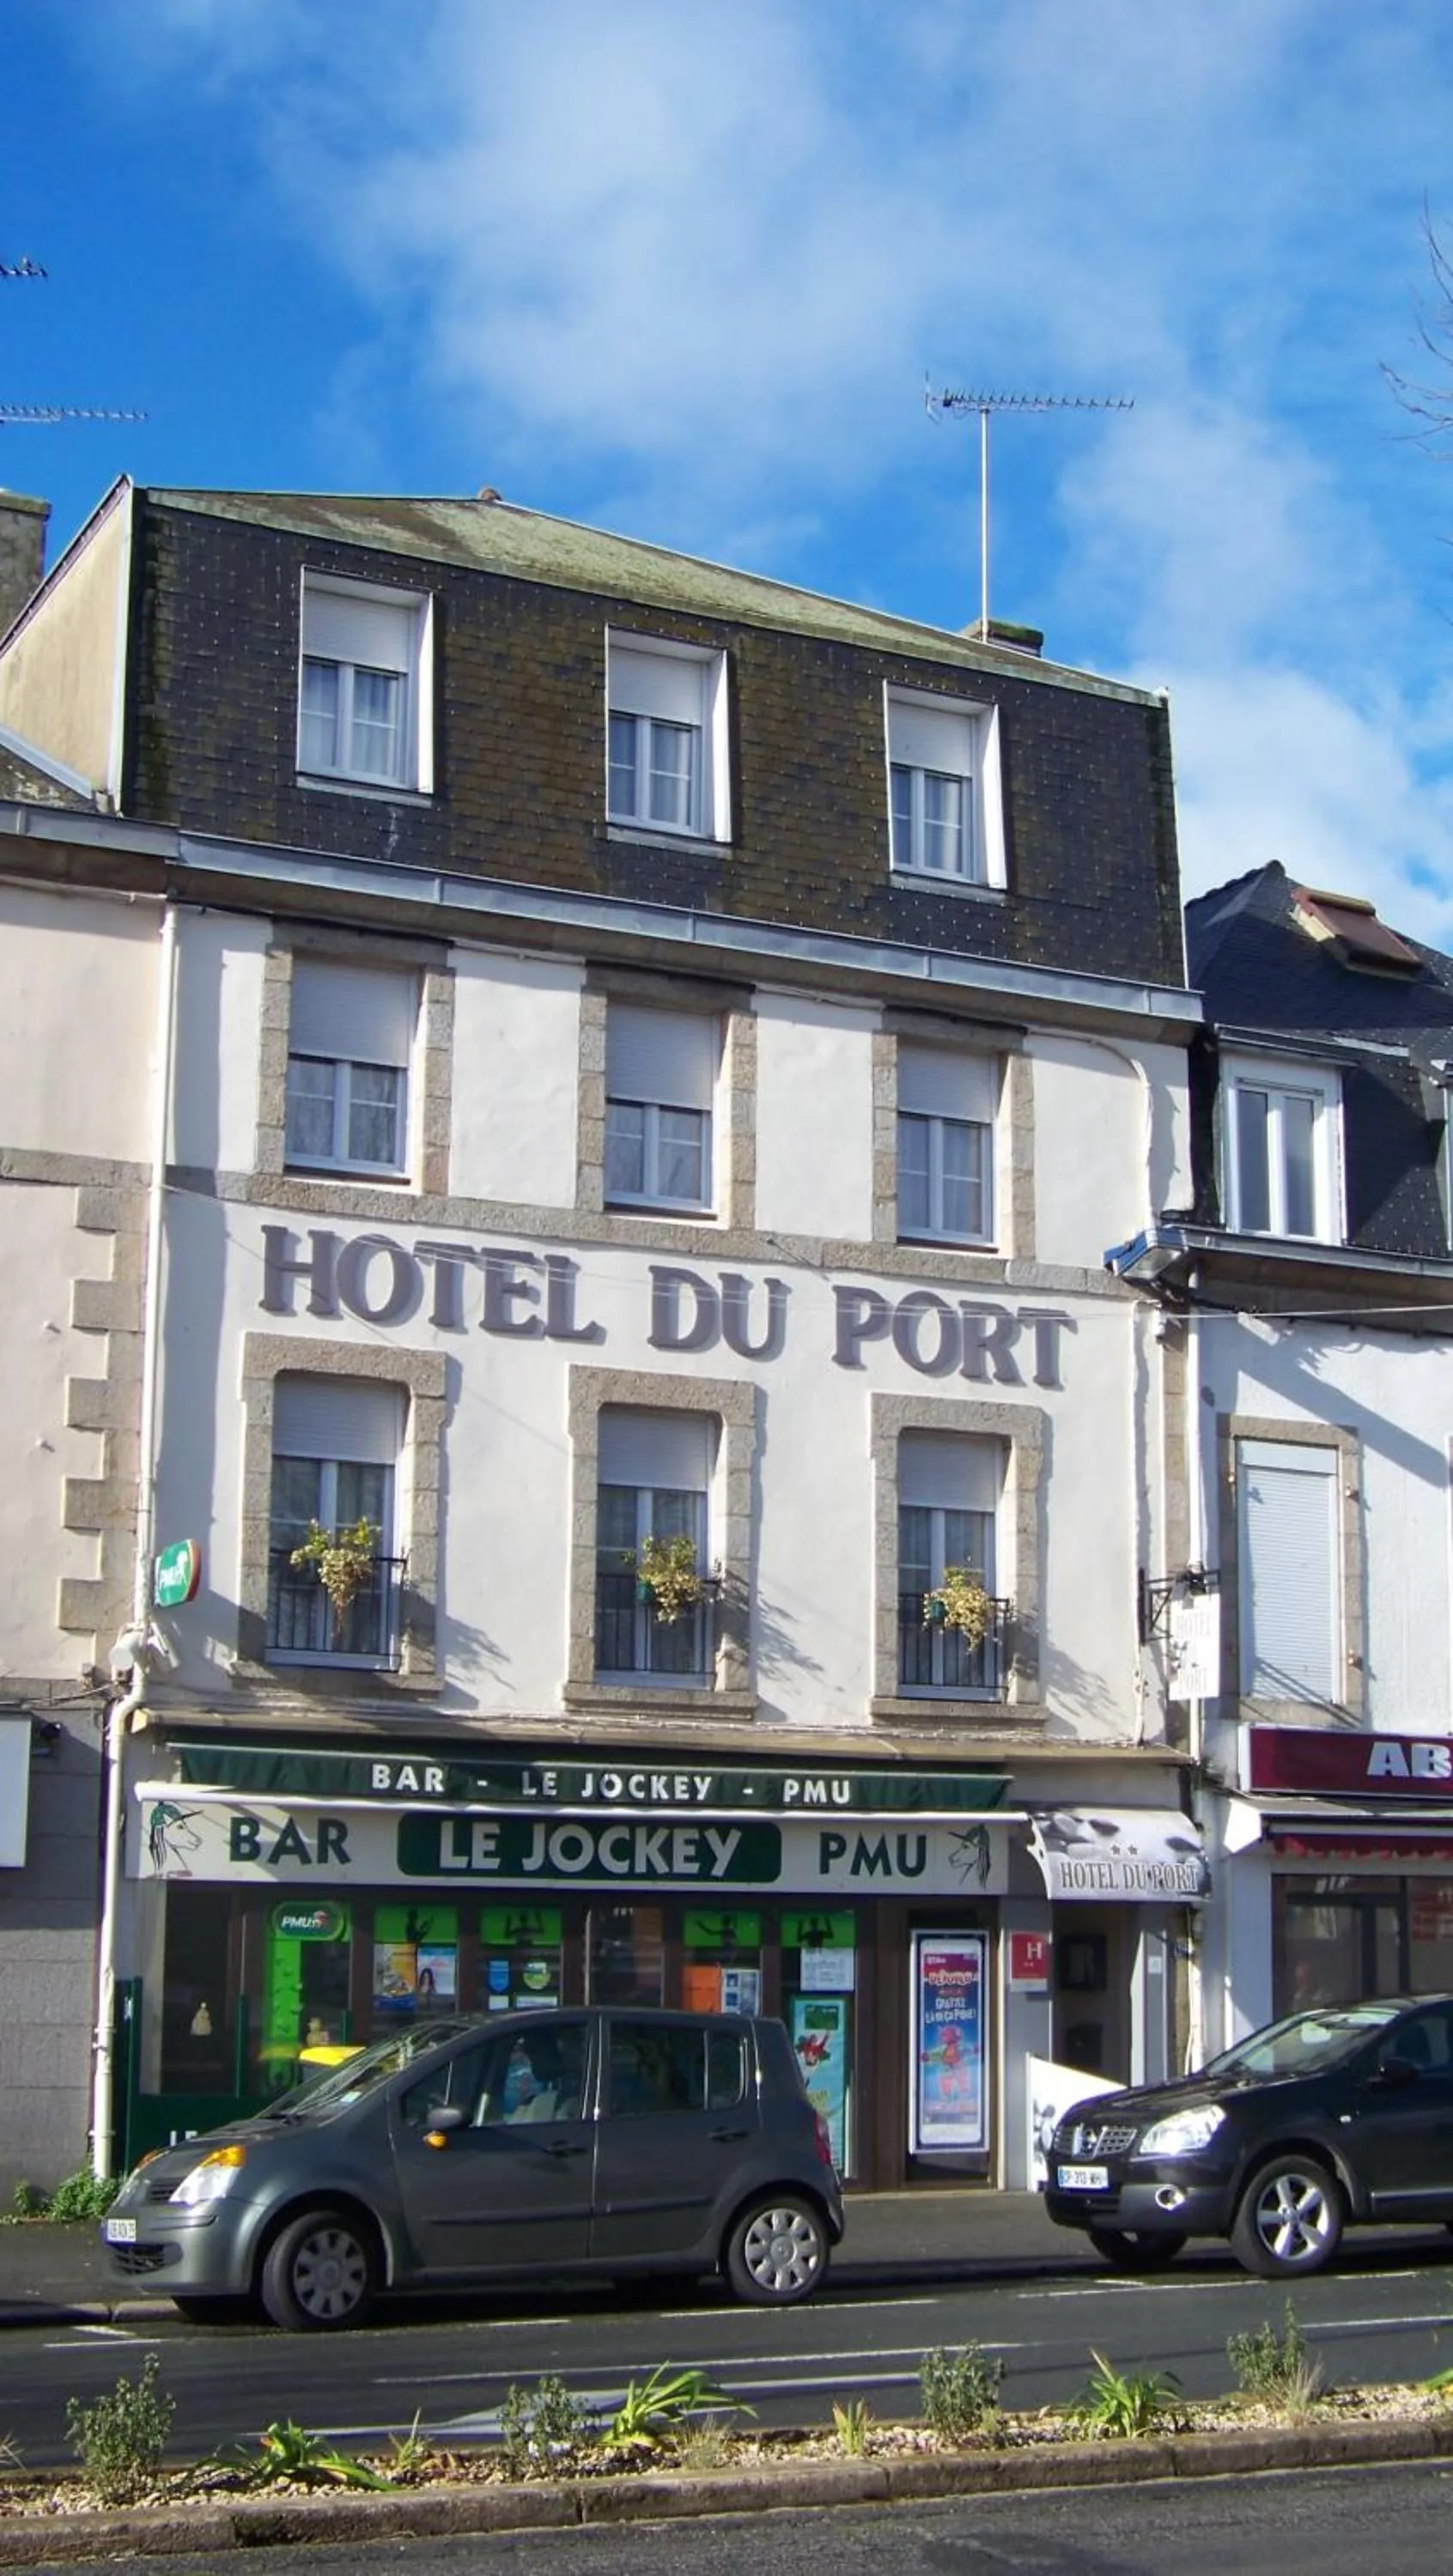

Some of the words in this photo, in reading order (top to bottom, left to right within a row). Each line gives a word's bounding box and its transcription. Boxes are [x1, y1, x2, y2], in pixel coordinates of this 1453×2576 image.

[258, 1224, 603, 1340] HOTEL
[647, 1265, 789, 1358] DU
[831, 1284, 1075, 1388] PORT
[372, 1764, 445, 1793] BAR
[521, 1771, 557, 1795] LE
[581, 1772, 712, 1801] JOCKEY
[783, 1779, 850, 1804] PMU
[229, 1817, 351, 1864] BAR
[440, 1820, 501, 1869] LE
[521, 1822, 742, 1877] JOCKEY
[819, 1832, 927, 1877] PMU
[1061, 1862, 1118, 1889] HOTEL
[1122, 1863, 1146, 1890] DU
[1152, 1863, 1198, 1892] PORT
[1026, 1941, 1042, 1959] H
